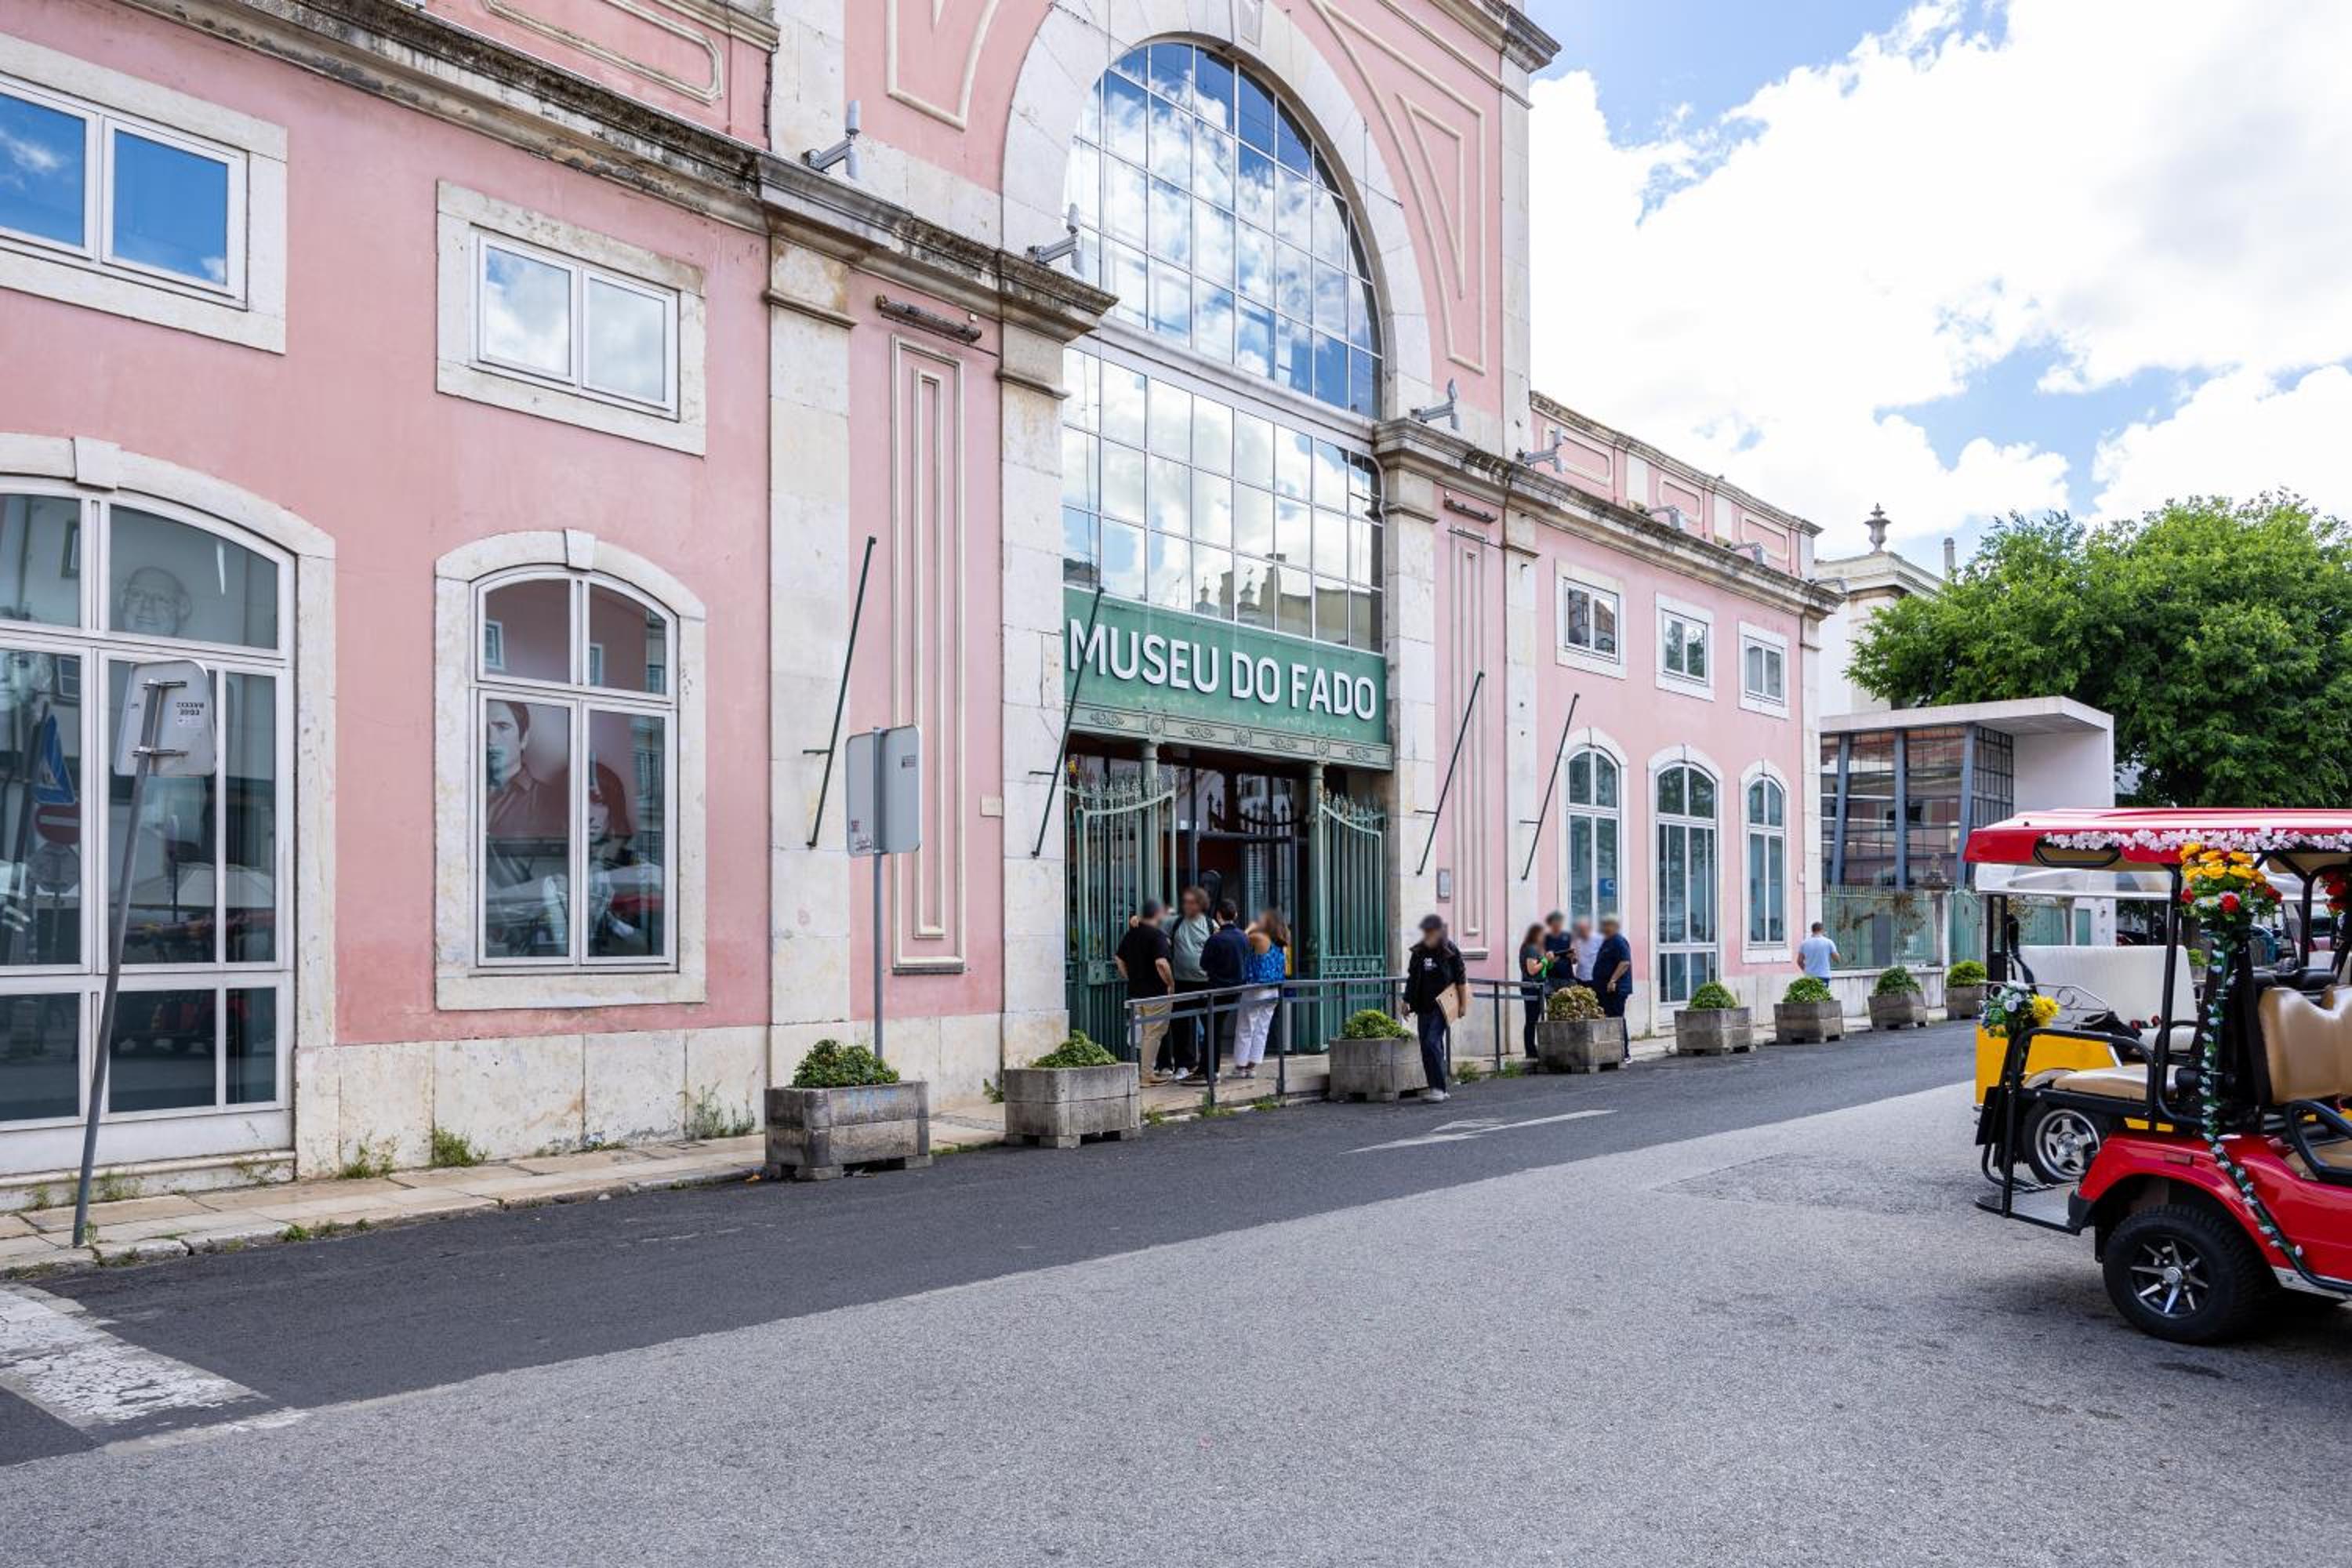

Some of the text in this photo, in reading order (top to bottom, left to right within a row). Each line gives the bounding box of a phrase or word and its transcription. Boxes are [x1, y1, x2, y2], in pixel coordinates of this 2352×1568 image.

[1069, 618, 1377, 721] MUSEU DO FADO
